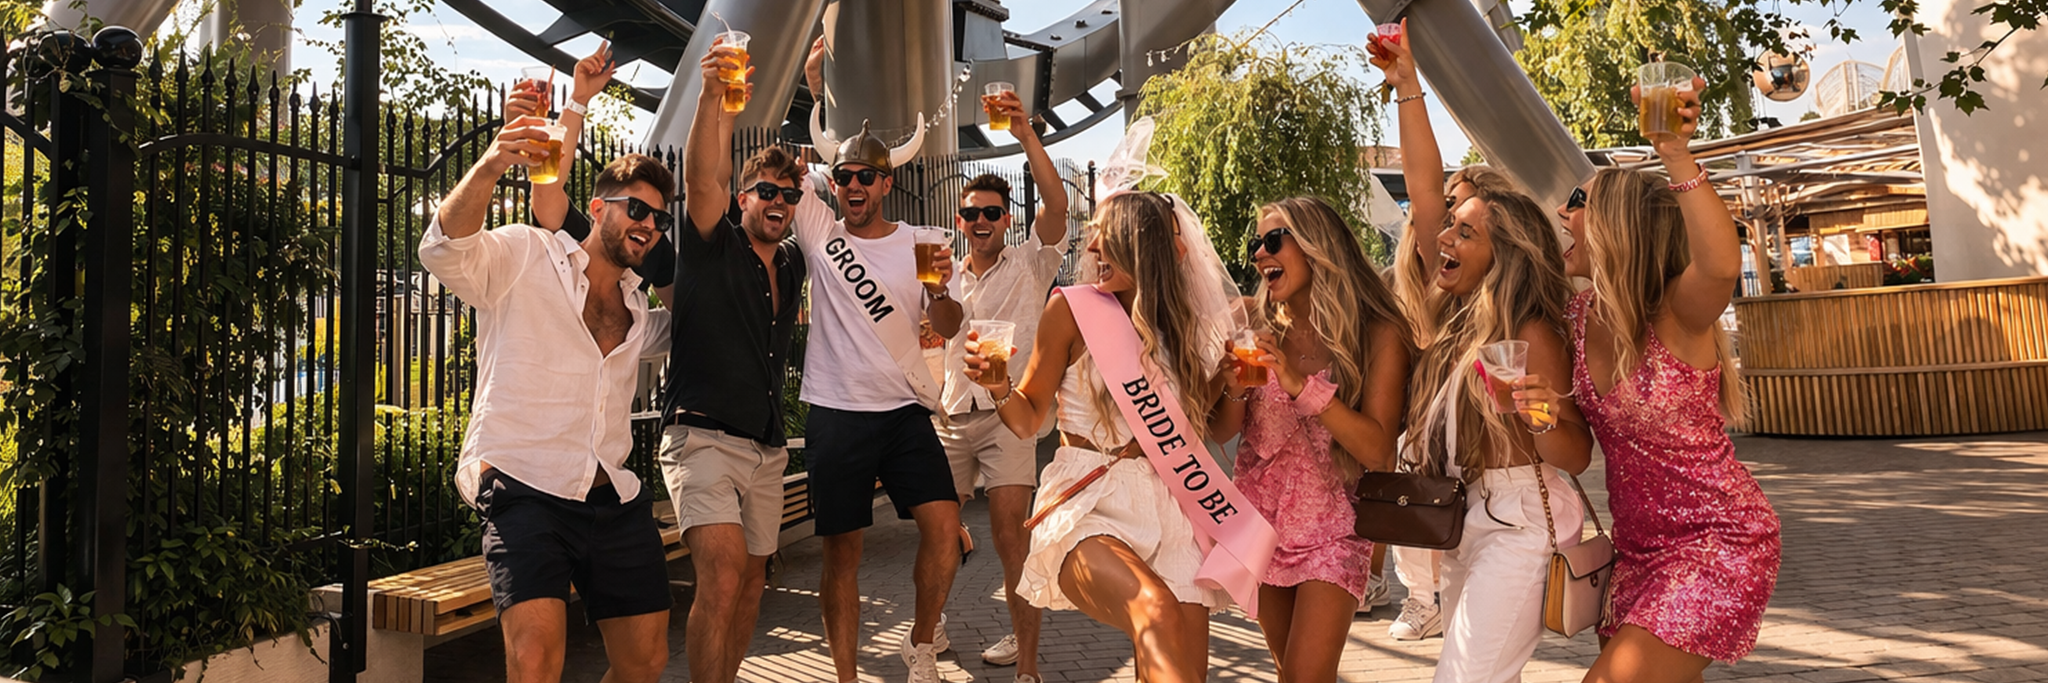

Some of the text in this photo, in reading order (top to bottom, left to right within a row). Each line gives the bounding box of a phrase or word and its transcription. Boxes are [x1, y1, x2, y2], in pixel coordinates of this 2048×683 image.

[825, 237, 895, 323] GROOM
[1122, 375, 1239, 525] BRIDE TO BE
